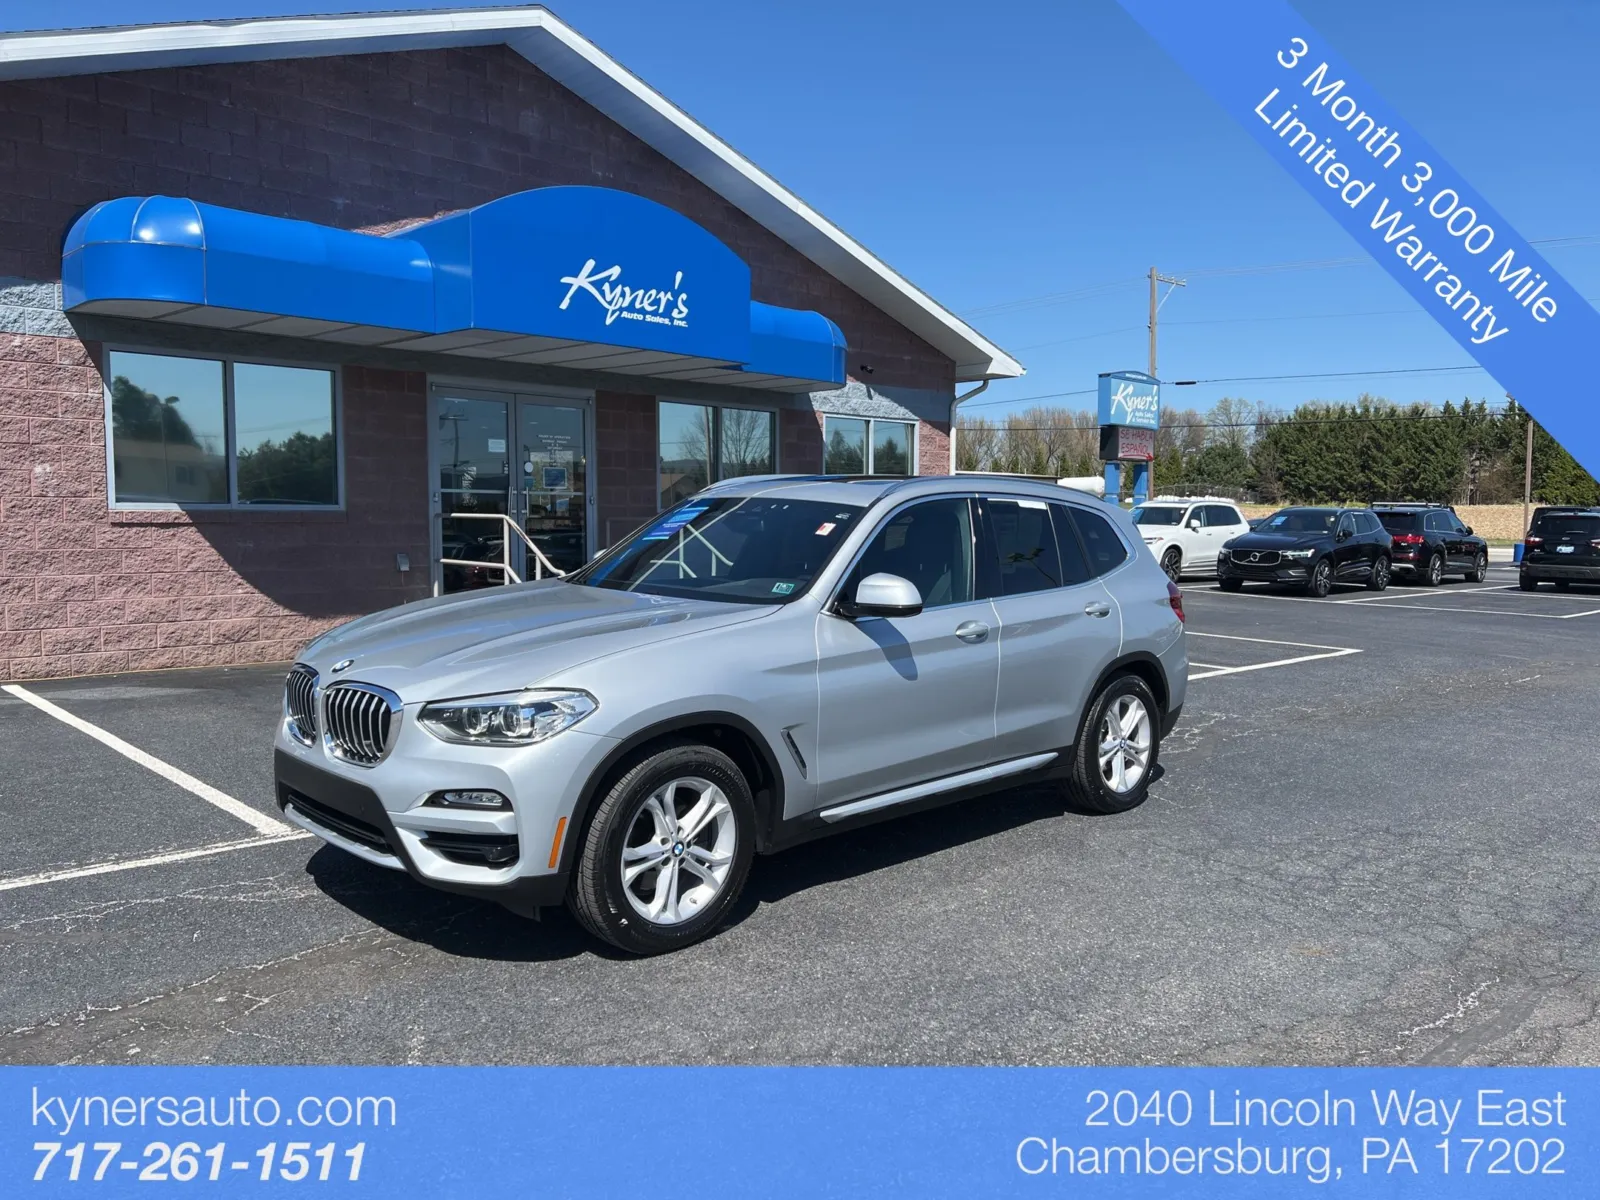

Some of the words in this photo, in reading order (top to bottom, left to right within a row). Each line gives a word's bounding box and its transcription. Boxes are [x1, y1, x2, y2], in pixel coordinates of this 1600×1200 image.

[559, 258, 689, 326] Kyner's
[621, 311, 644, 321] Auto
[645, 314, 671, 326] Sales,
[673, 319, 688, 328] Inc.
[1110, 382, 1158, 424] Kyner's
[1132, 430, 1153, 442] HABLA
